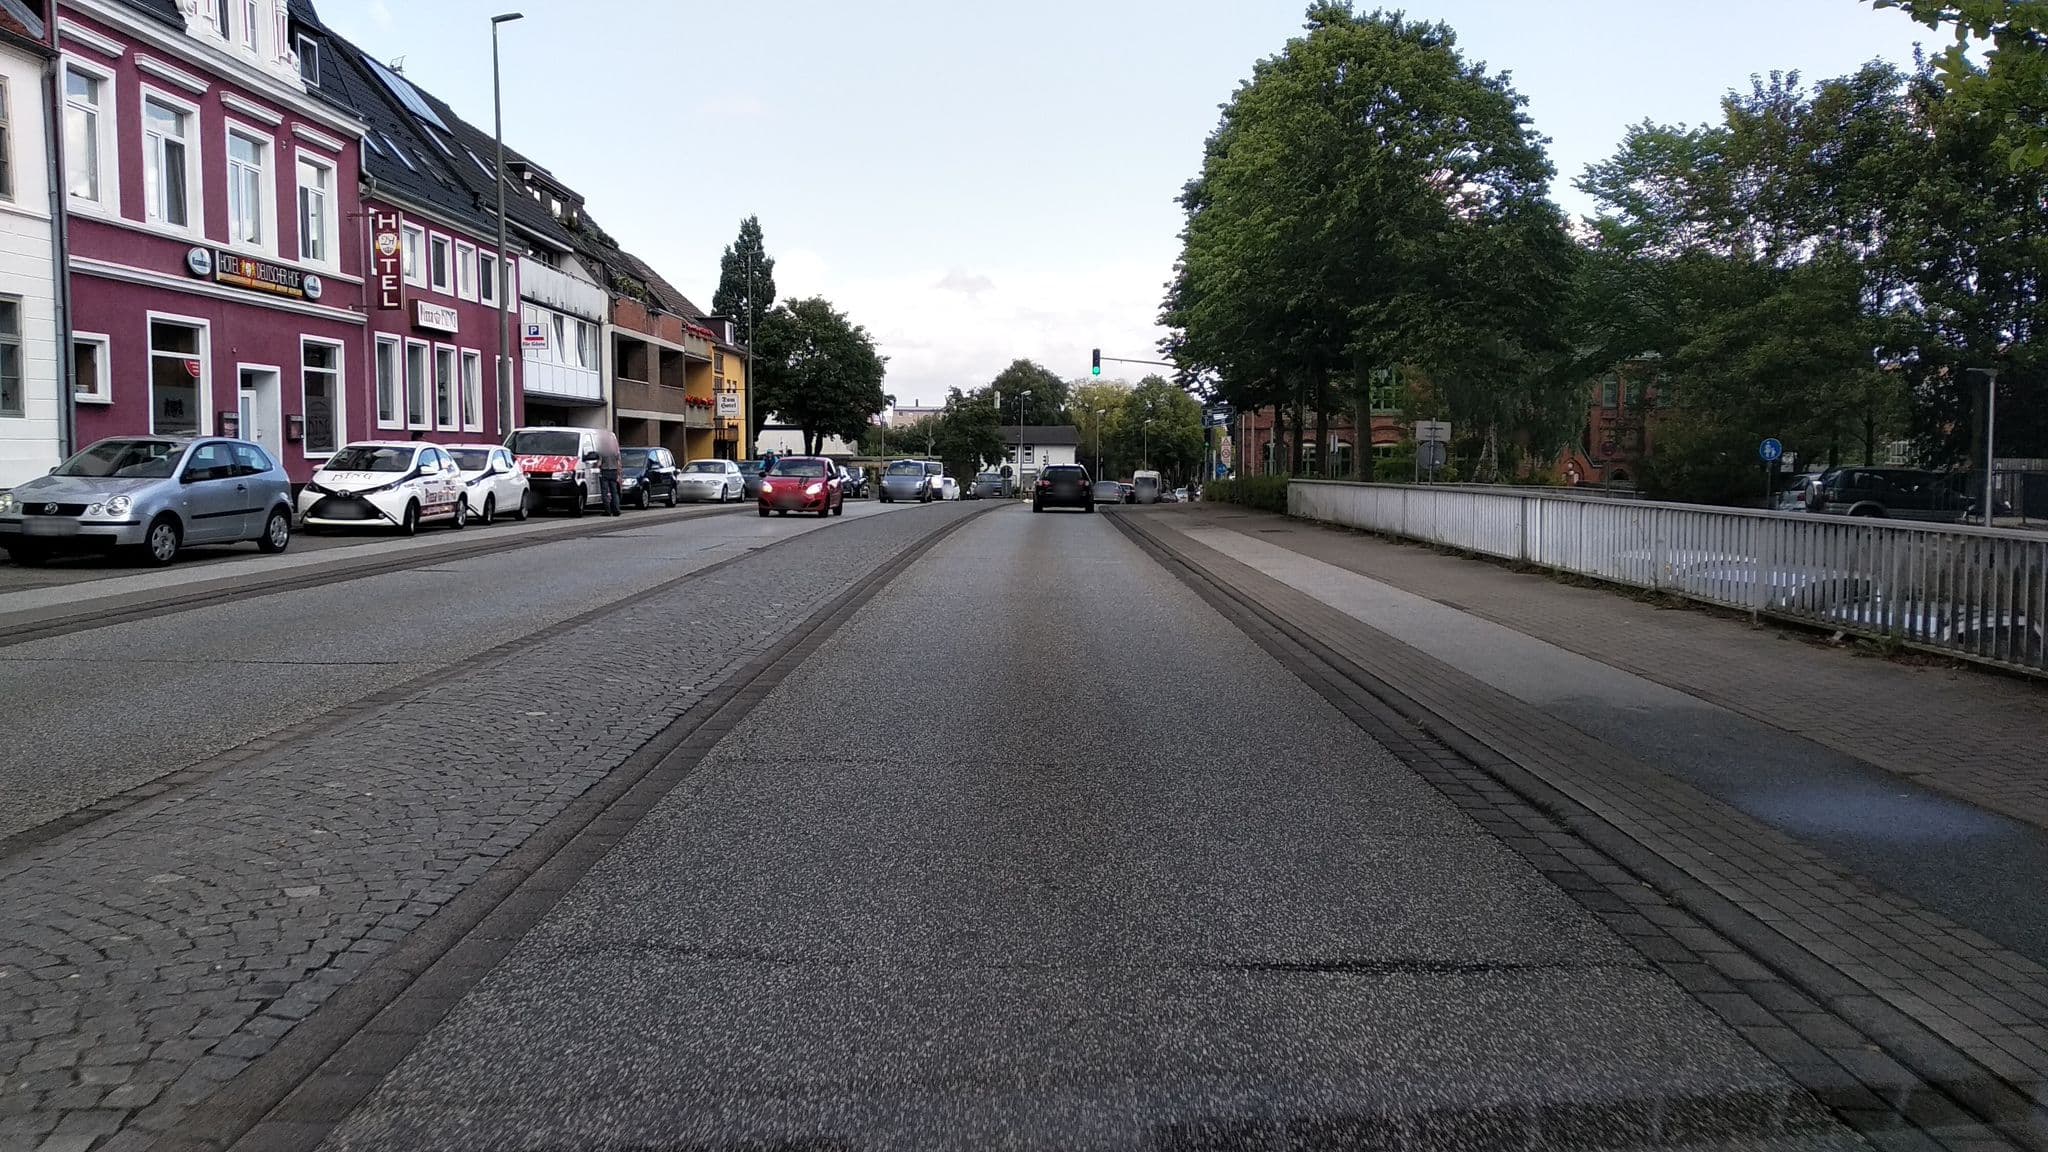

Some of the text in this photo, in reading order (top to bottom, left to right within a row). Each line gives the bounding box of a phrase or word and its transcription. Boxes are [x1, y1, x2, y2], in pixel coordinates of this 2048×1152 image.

[219, 254, 240, 276] HOTEL
[256, 262, 288, 285] DEUTSCHER
[288, 271, 300, 288] HOF
[530, 326, 538, 335] P
